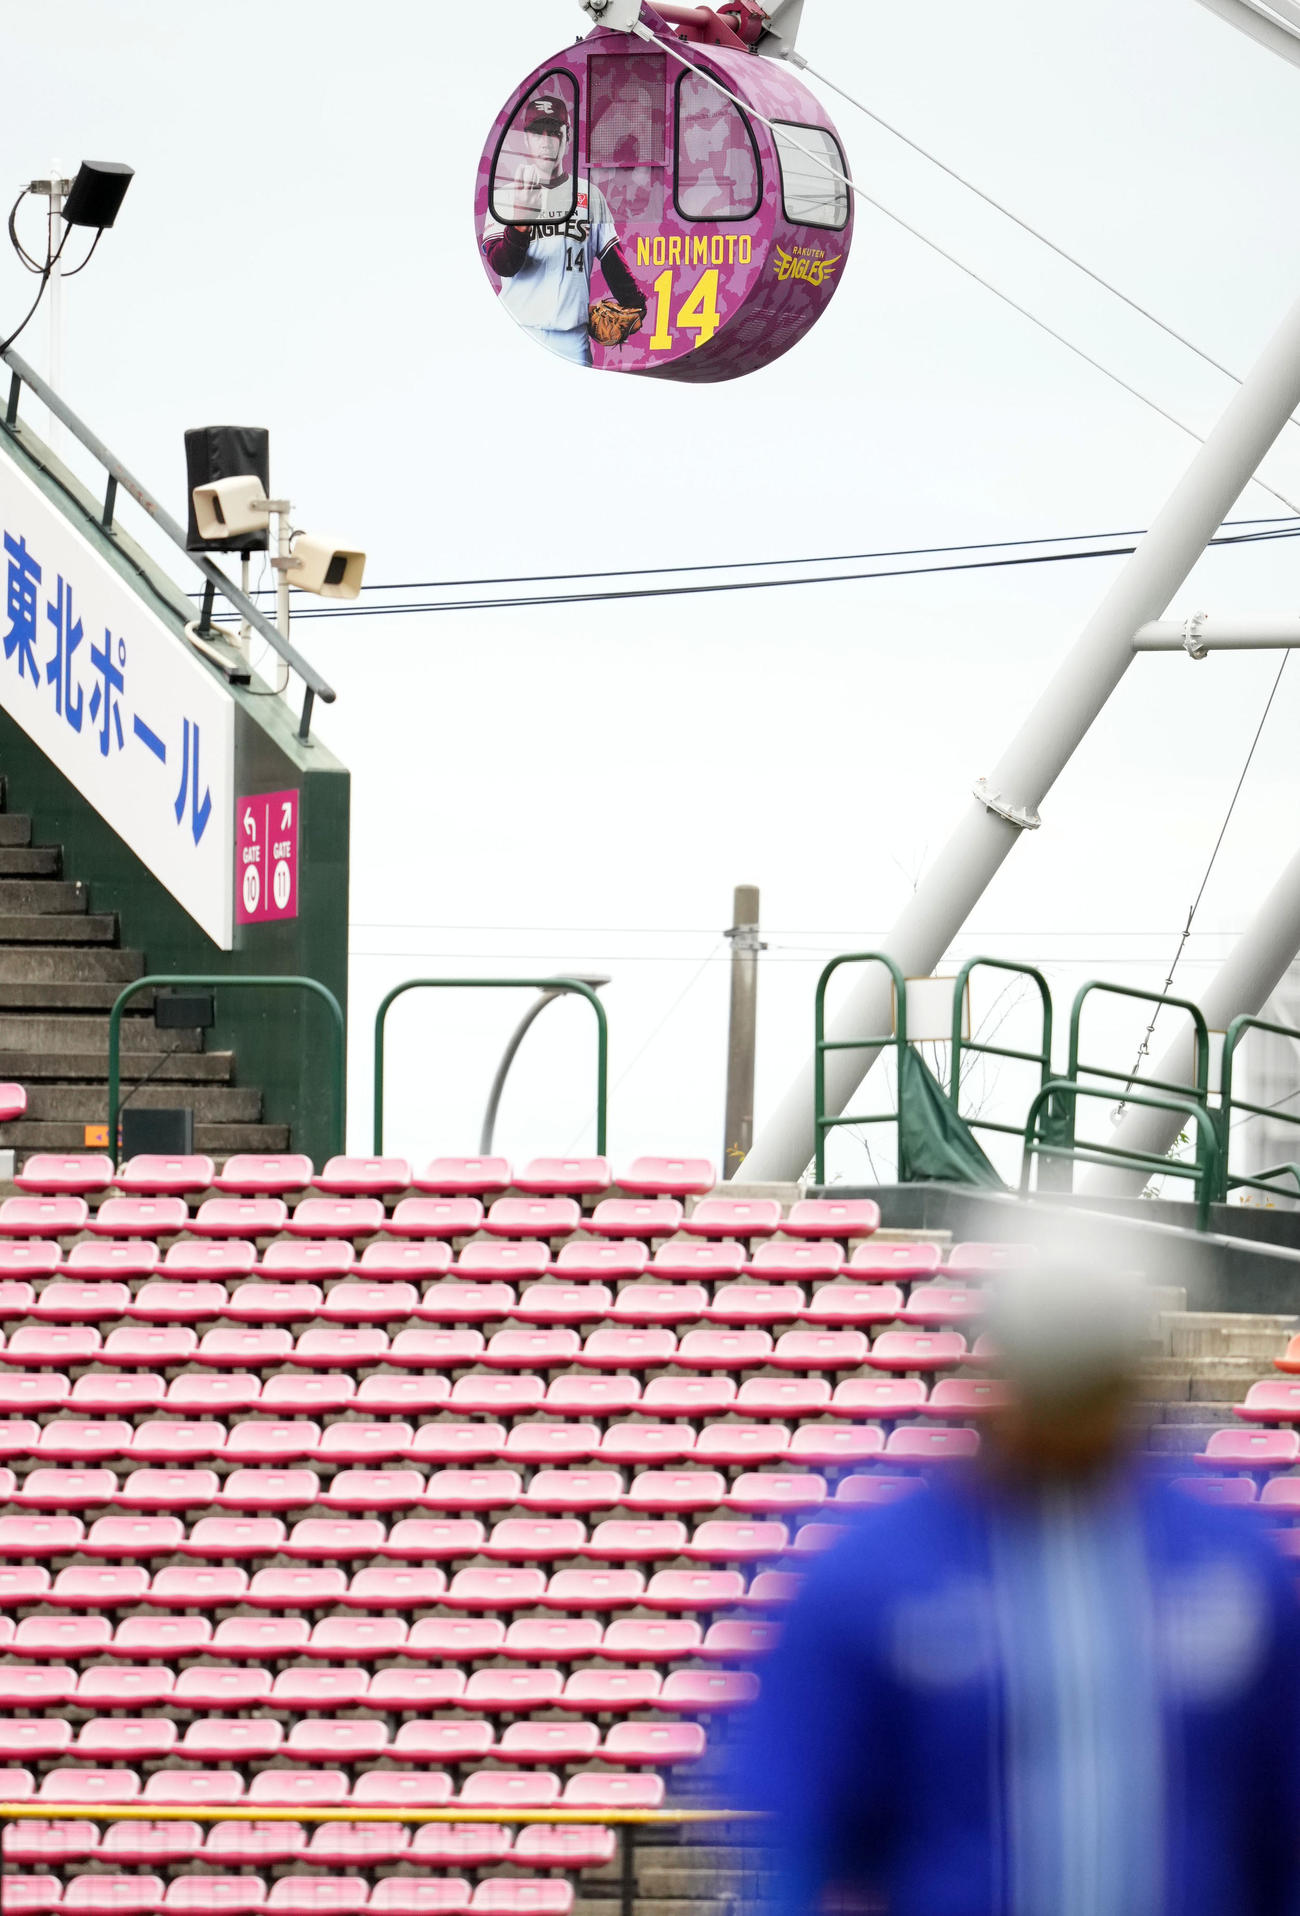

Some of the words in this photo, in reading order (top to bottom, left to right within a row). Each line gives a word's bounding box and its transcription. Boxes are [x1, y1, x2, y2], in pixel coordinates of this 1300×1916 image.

[566, 247, 584, 272] 14
[636, 235, 752, 266] NORIMOTO
[793, 246, 825, 258] RAKUTEN
[774, 249, 837, 286] EAGLES
[649, 269, 721, 351] 14
[3, 530, 212, 846] 東北ポール
[243, 845, 260, 863] GATE
[273, 841, 291, 859] GATE
[246, 876, 257, 902] 10
